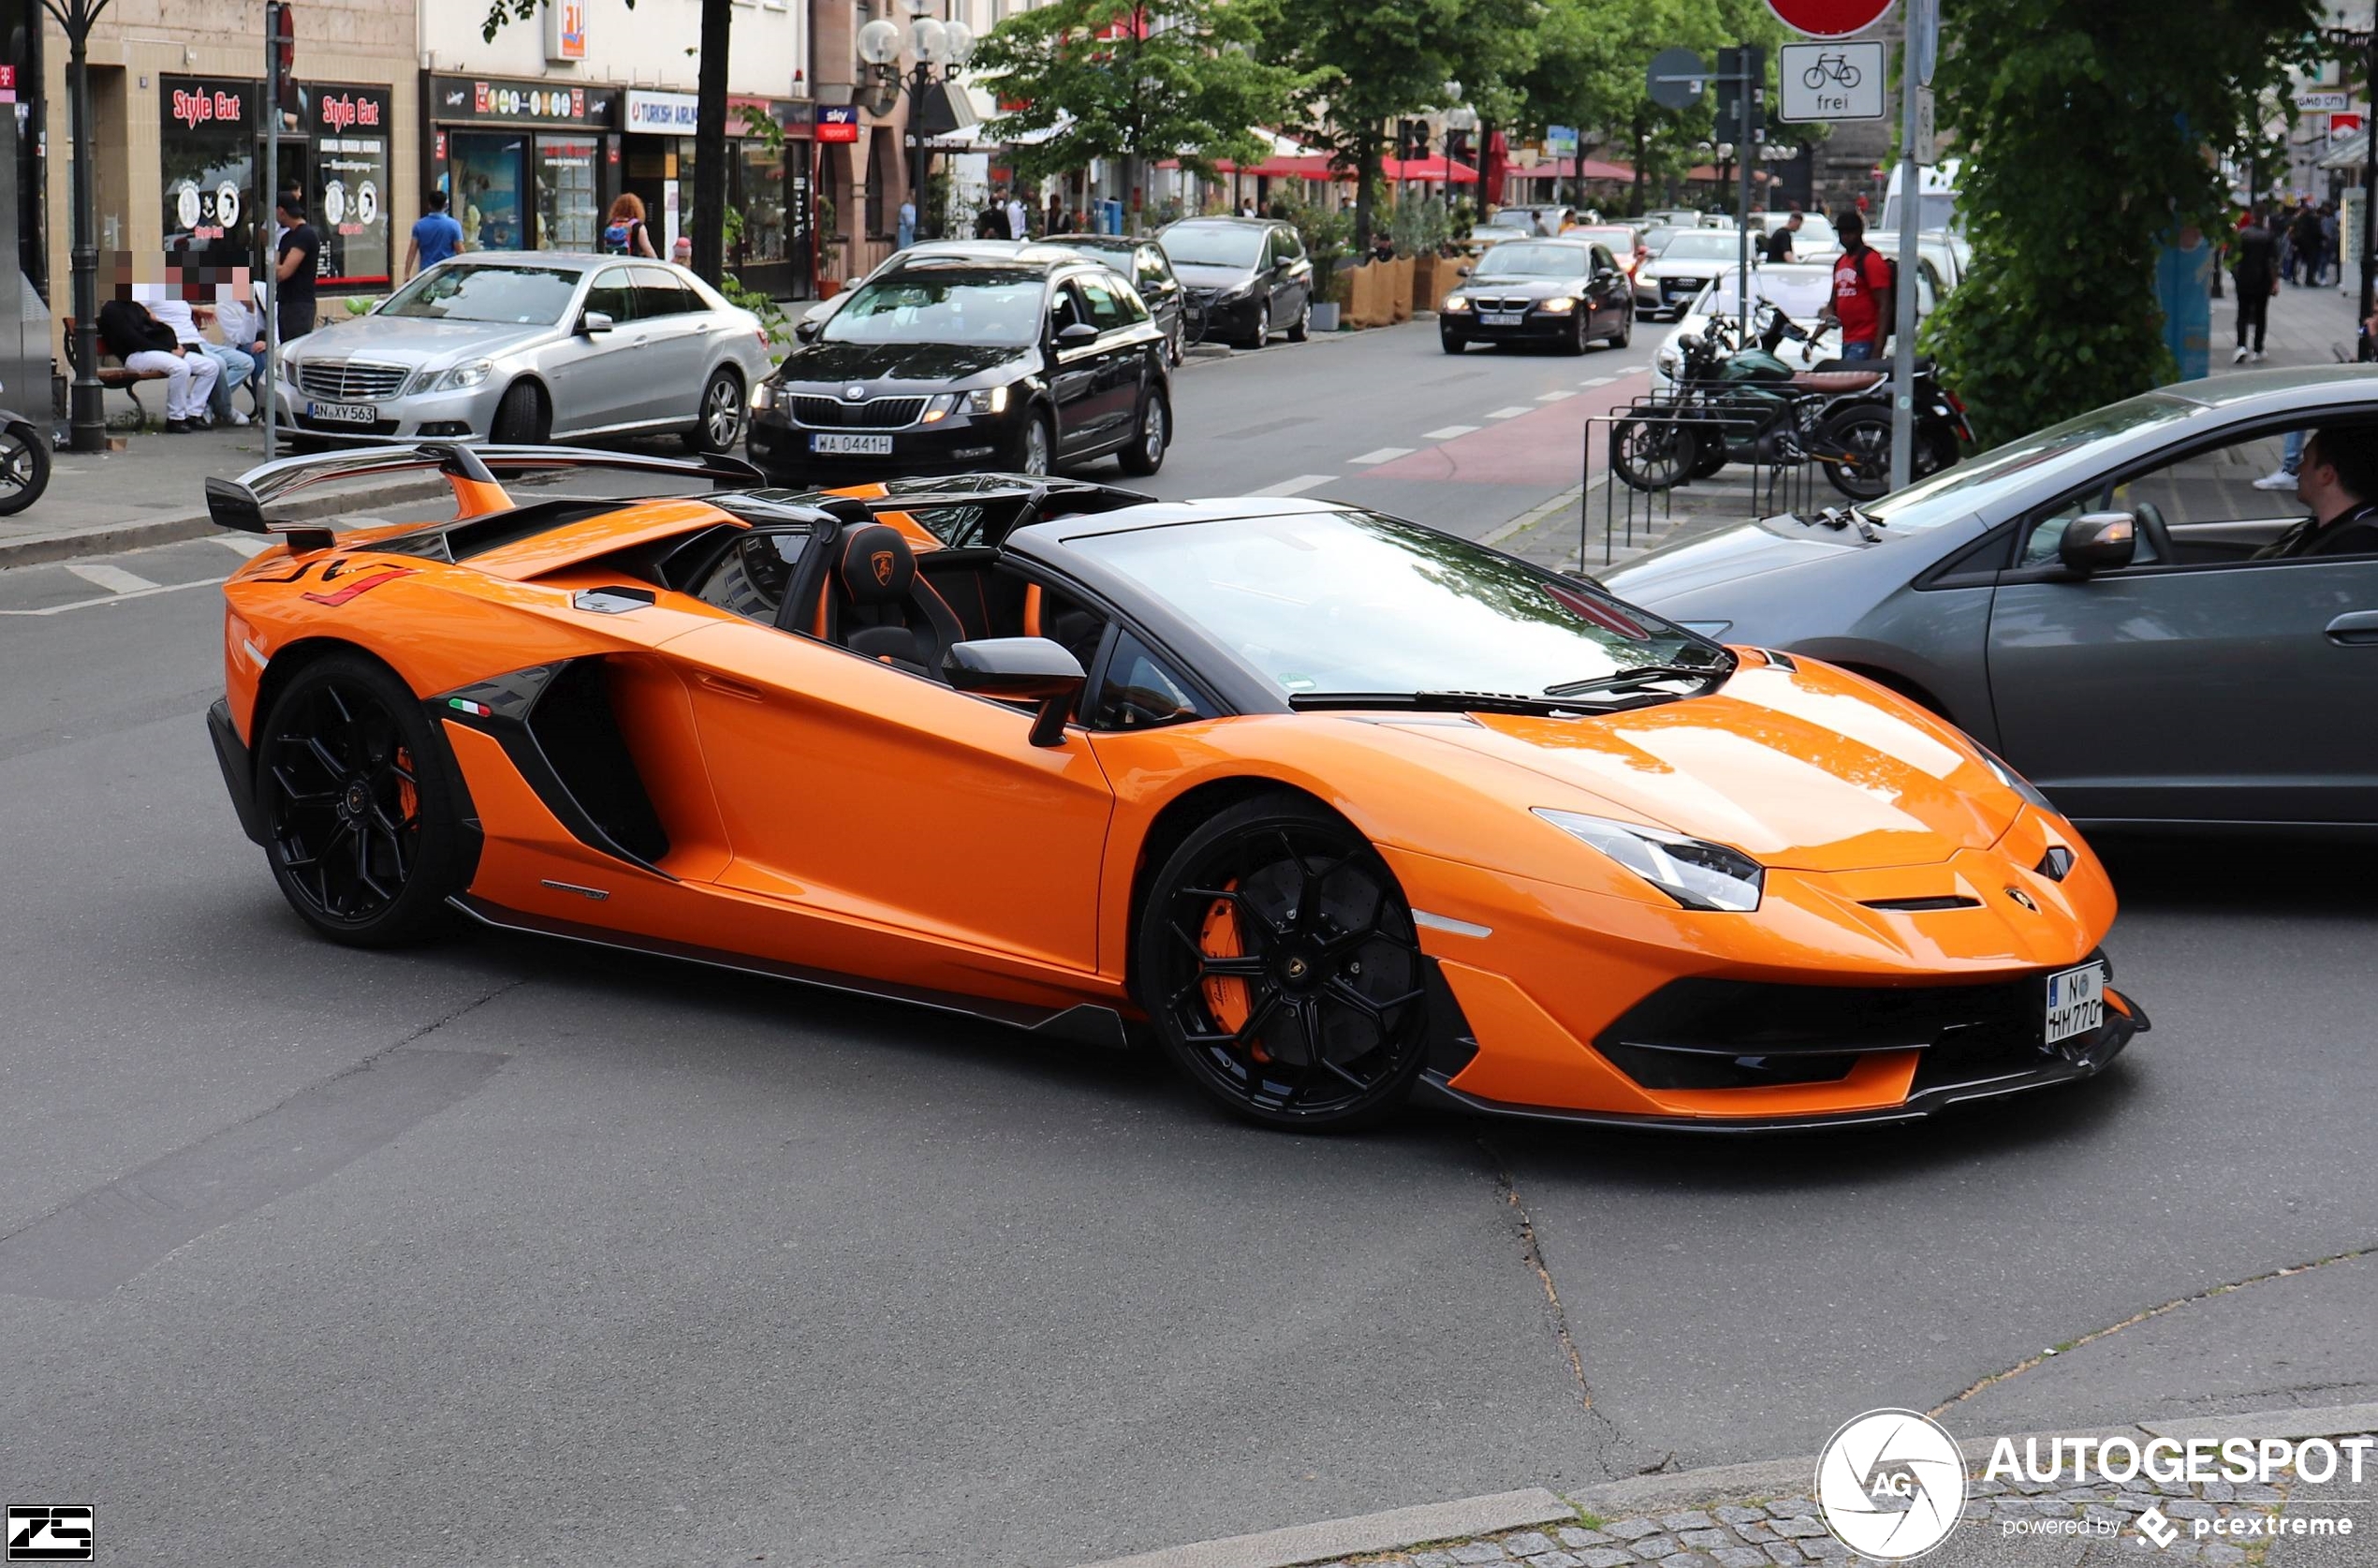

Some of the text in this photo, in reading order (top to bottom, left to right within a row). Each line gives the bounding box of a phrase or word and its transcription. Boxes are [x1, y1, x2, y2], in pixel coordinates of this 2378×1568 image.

[173, 87, 241, 130] Style Cut
[1817, 94, 1849, 110] frei
[323, 93, 379, 133] Style Cut
[641, 103, 672, 124] TURKISH
[827, 109, 848, 124] sky
[825, 126, 849, 139] sport
[315, 404, 374, 421] AN XY 563
[819, 436, 888, 452] WA 0441H
[2068, 975, 2078, 1003] N
